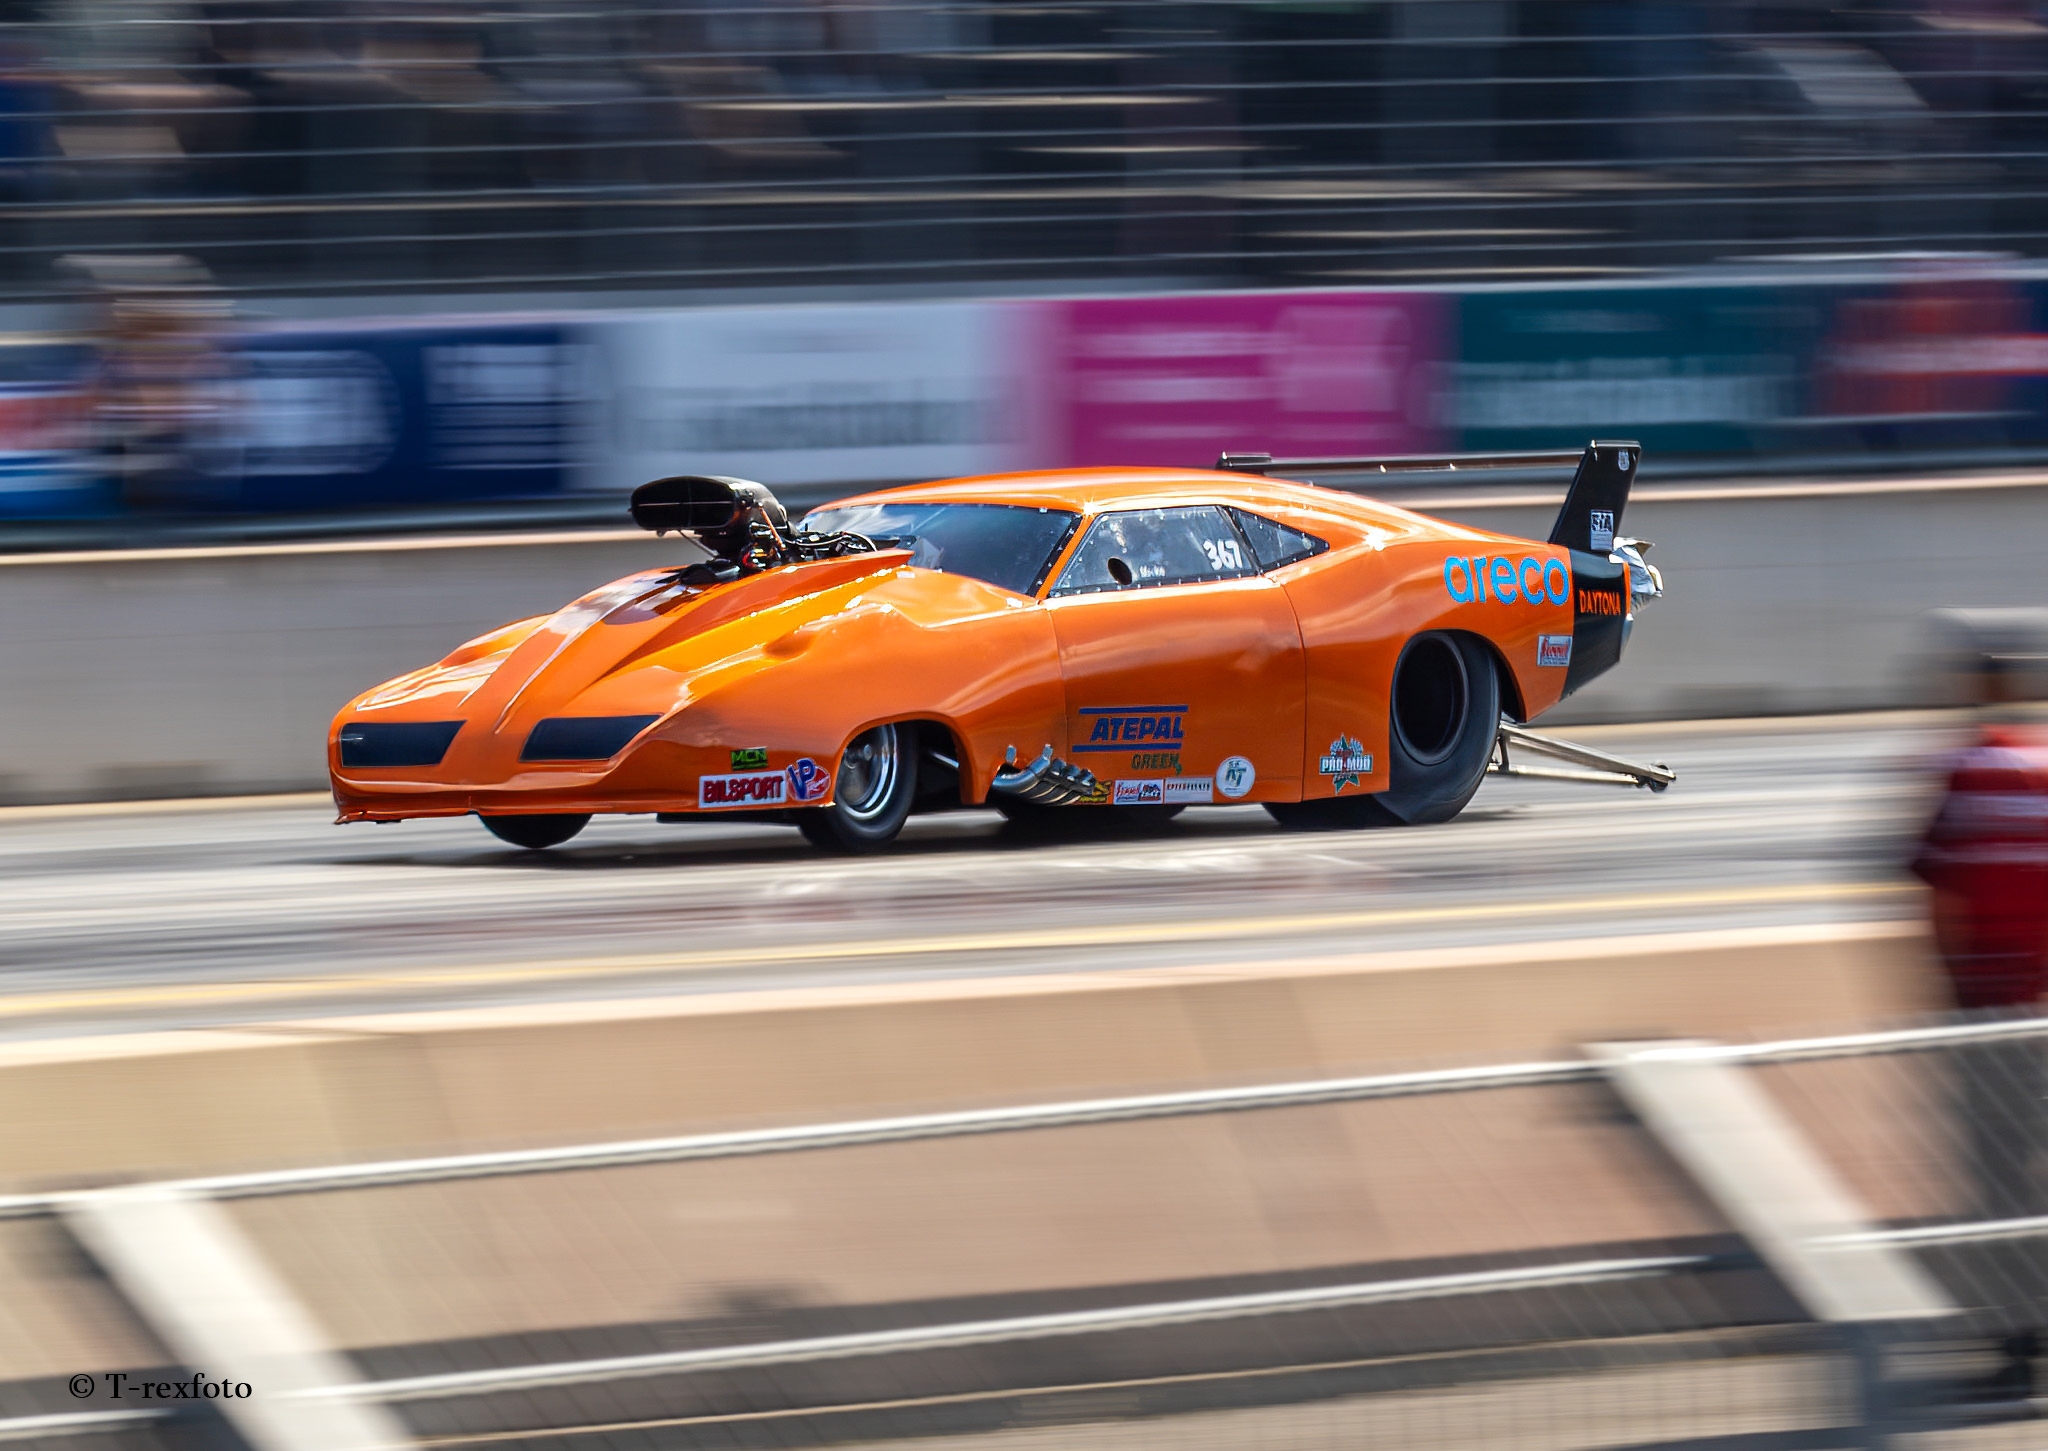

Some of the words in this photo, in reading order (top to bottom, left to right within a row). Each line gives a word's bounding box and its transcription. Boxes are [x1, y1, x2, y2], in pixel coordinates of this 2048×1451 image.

[1203, 538, 1243, 571] 367
[1443, 556, 1570, 606] areco
[1579, 590, 1620, 615] DAYTONA
[1090, 715, 1185, 742] ATEPAL
[703, 776, 783, 803] BILSPORT
[787, 759, 816, 800] VP
